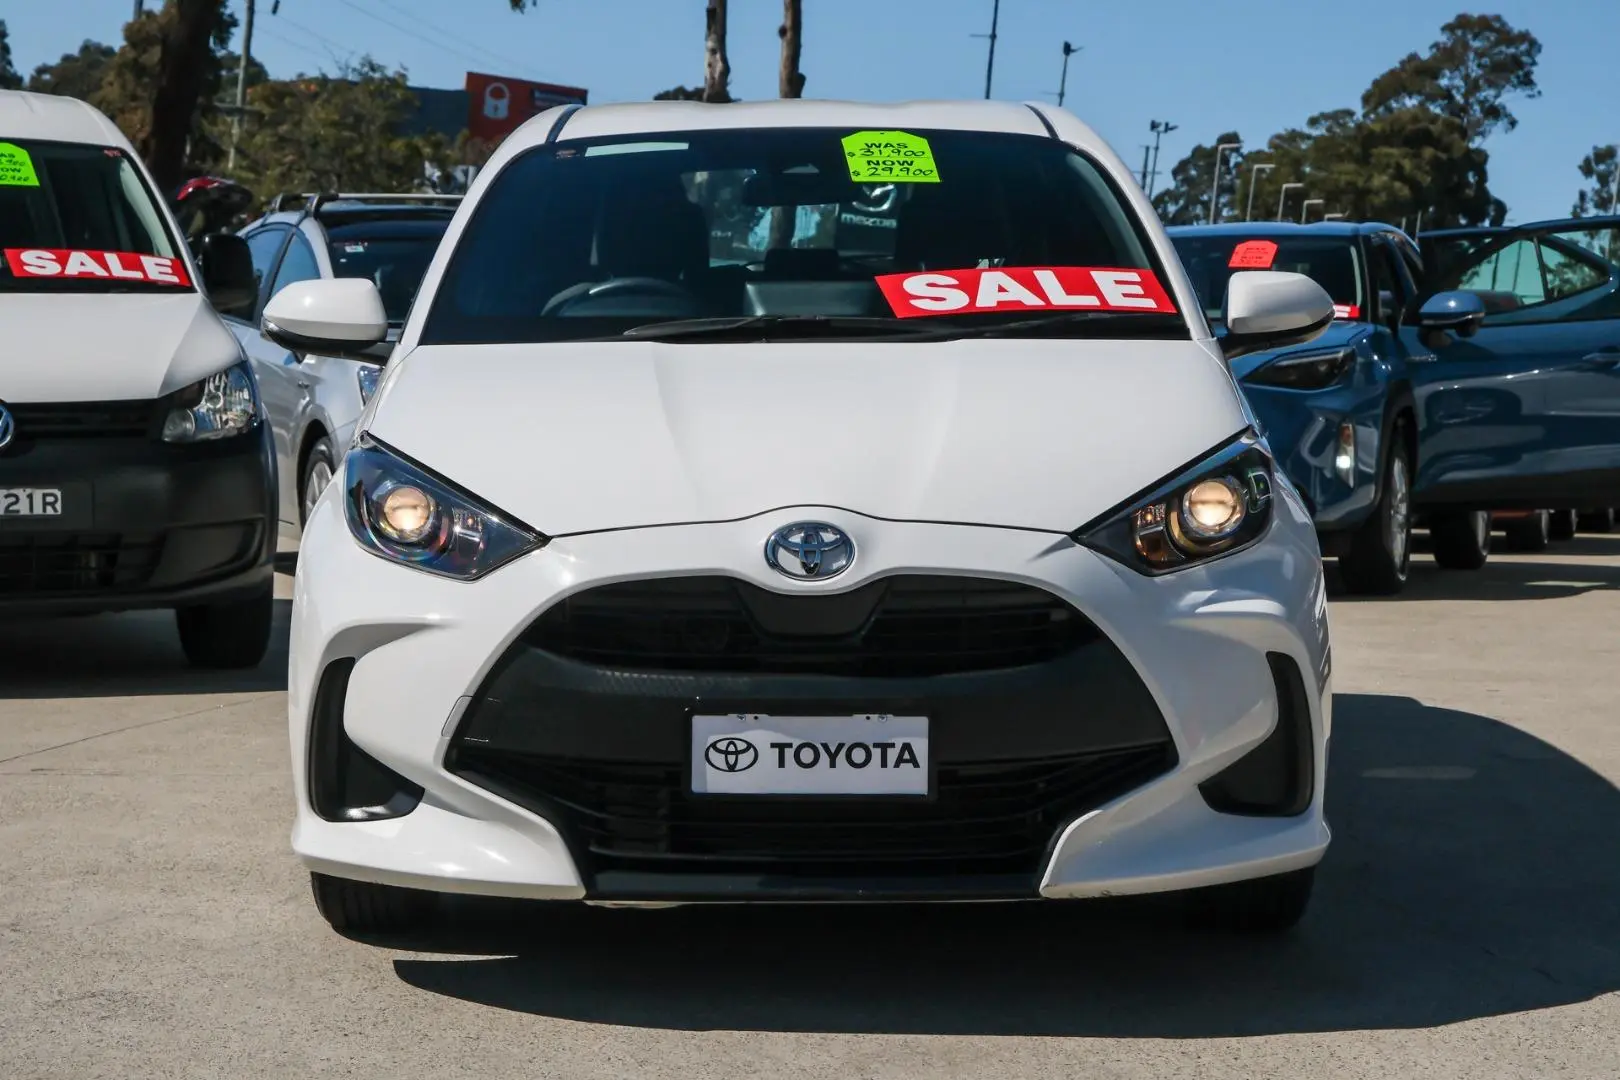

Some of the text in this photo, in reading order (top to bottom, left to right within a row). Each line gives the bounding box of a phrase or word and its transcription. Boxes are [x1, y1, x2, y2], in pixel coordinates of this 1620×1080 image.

[20, 249, 180, 283] SALE
[902, 269, 1158, 312] SALE
[770, 742, 921, 769] TOYOTA
